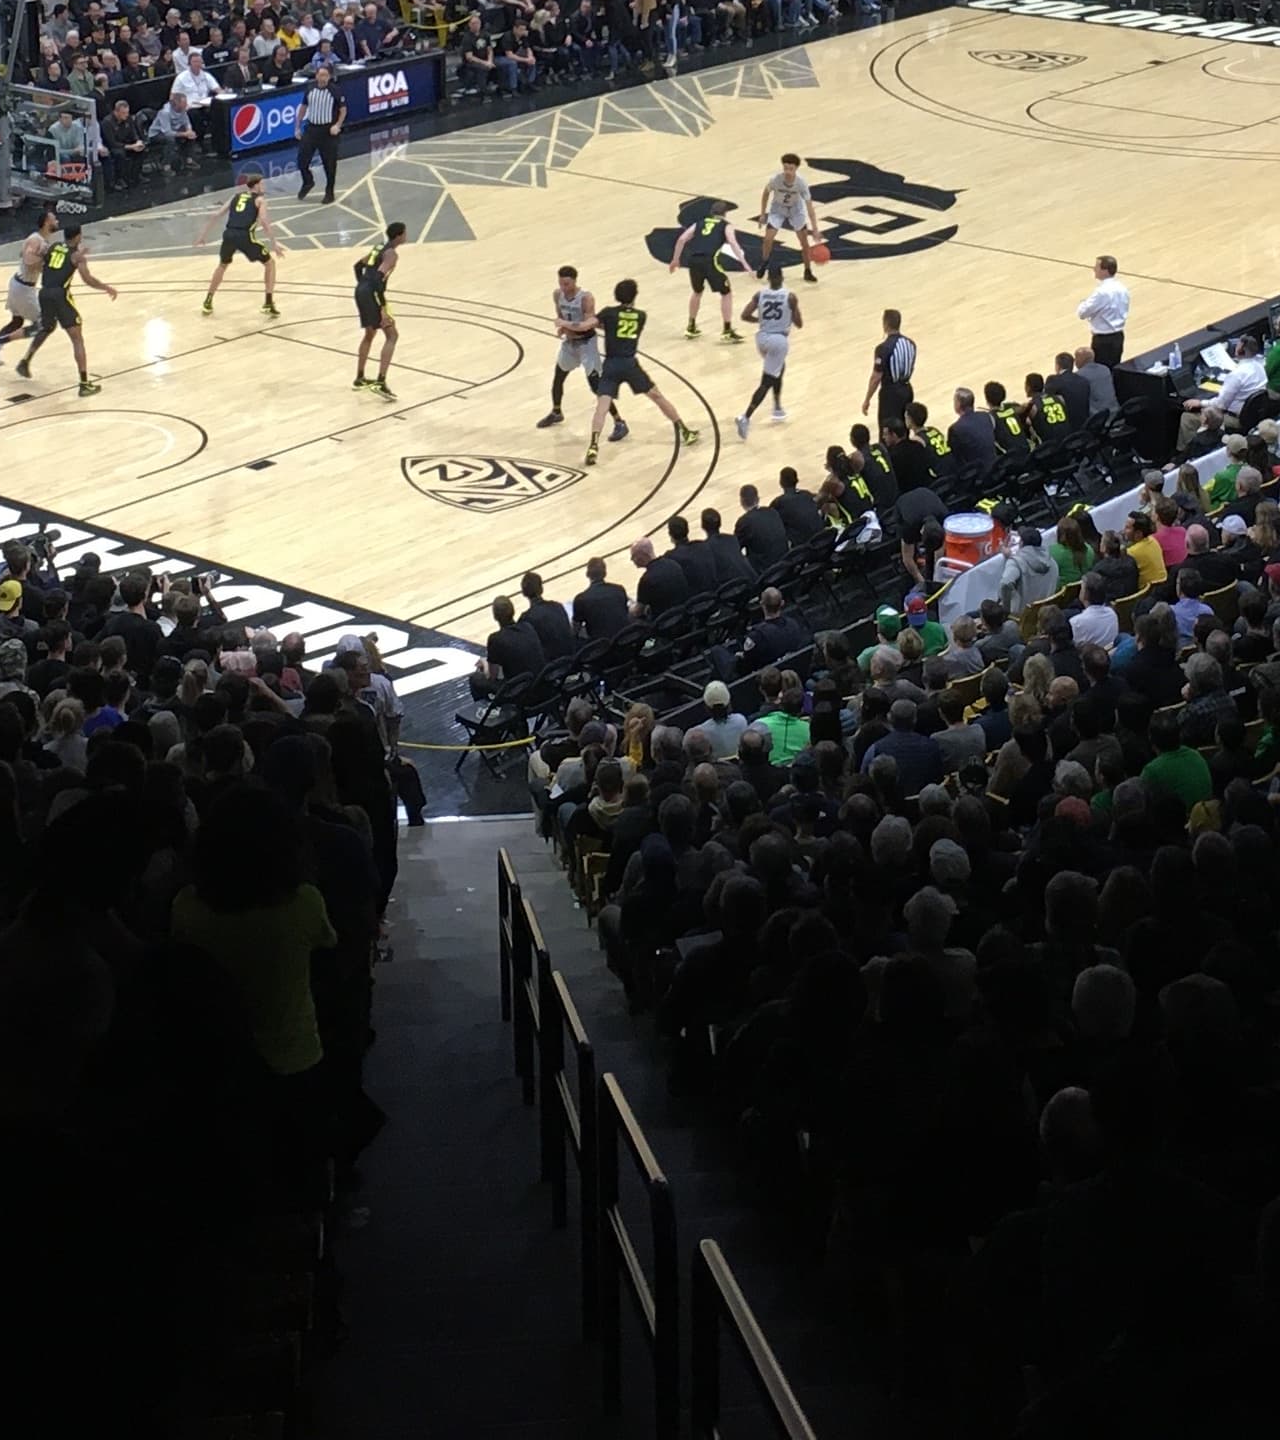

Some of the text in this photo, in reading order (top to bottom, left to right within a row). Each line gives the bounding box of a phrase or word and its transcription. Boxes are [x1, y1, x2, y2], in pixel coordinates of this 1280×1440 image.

[369, 70, 409, 101] KOA
[235, 197, 249, 213] 5
[762, 300, 784, 321] 25
[616, 319, 639, 339] 22
[1043, 402, 1066, 424] 33
[1006, 417, 1021, 436] 0
